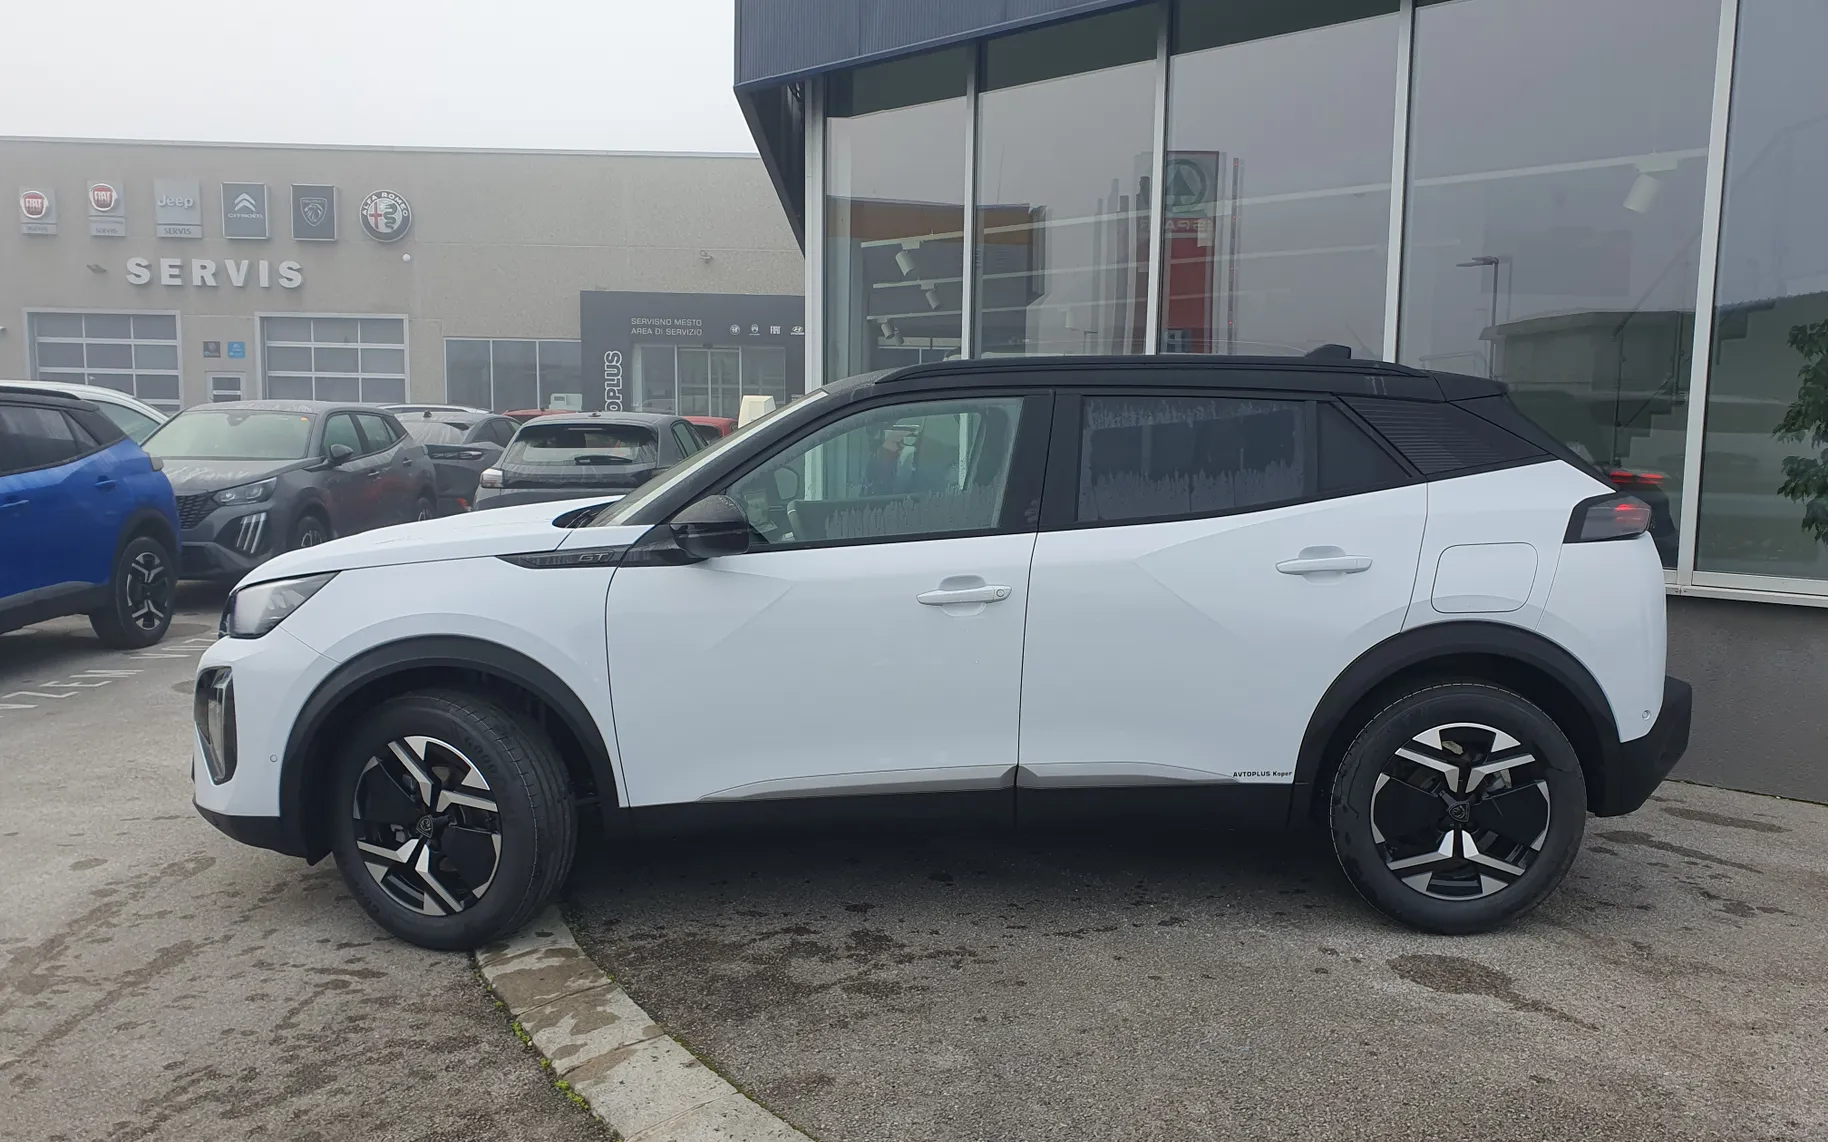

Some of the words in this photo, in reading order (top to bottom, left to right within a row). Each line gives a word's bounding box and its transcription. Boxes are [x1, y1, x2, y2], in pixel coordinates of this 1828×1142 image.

[94, 190, 111, 203] FIAT
[157, 194, 194, 209] Jeep
[25, 198, 42, 208] FIAT
[361, 194, 378, 216] ALFA
[381, 191, 409, 217] ROMEO
[163, 227, 192, 235] SERVIS
[126, 257, 304, 289] SERVIS
[631, 317, 672, 326] SERVISNO
[674, 318, 702, 327] MESTO
[631, 327, 653, 335] AREA
[655, 328, 663, 336] DI
[665, 328, 703, 336] SERVIZIO
[579, 553, 608, 562] GT
